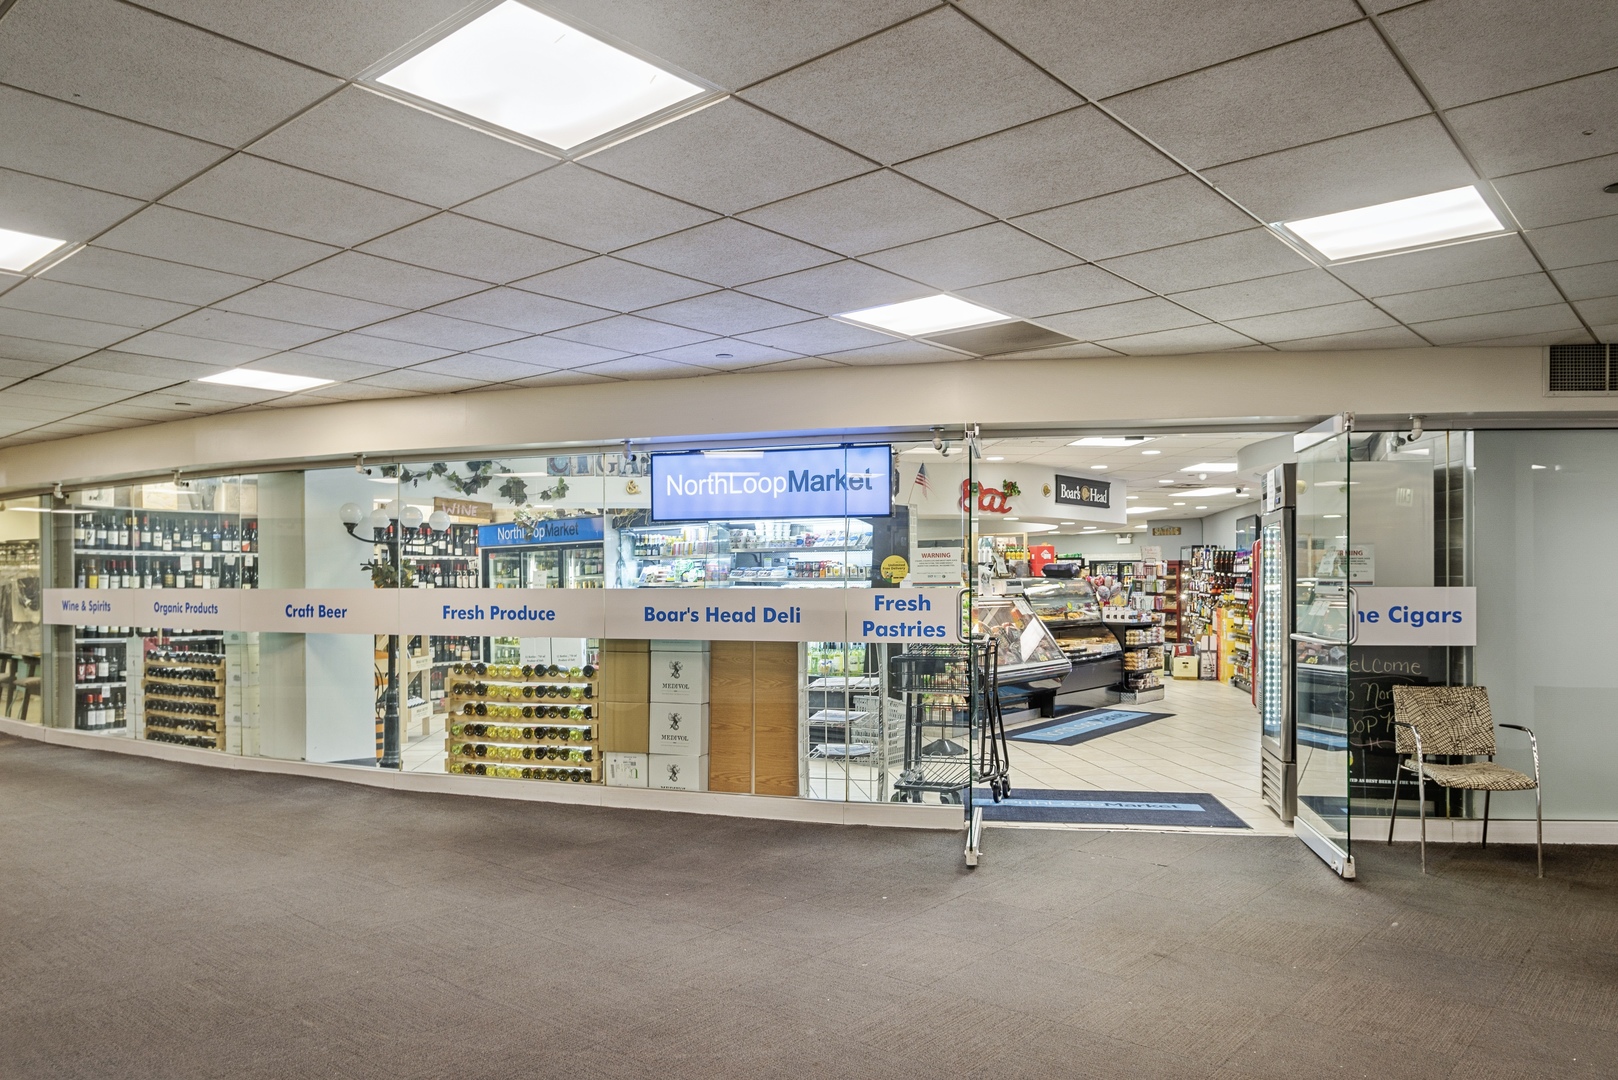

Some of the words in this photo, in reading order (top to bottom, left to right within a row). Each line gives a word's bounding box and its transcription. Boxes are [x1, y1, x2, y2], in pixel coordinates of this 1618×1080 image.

[666, 468, 873, 498] NorthLoopMarket
[1060, 483, 1081, 500] Boar's
[1090, 487, 1108, 504] Head
[441, 502, 478, 516] WINE
[62, 599, 79, 612] Wine
[81, 601, 87, 612] &
[89, 601, 111, 614] Spirits
[153, 602, 183, 617] Organic
[185, 602, 218, 615] Products
[873, 593, 931, 611] Fresh
[285, 604, 315, 619] Craft
[318, 605, 347, 619] Beer
[442, 605, 485, 620] Fresh
[490, 605, 556, 621] Produce
[643, 605, 700, 623] Boar's
[705, 606, 757, 623] Head
[763, 606, 801, 624] Deli
[1357, 610, 1380, 624] ne
[1388, 605, 1463, 629] Cigars
[863, 619, 946, 638] Pastries
[1349, 653, 1422, 675] elcome
